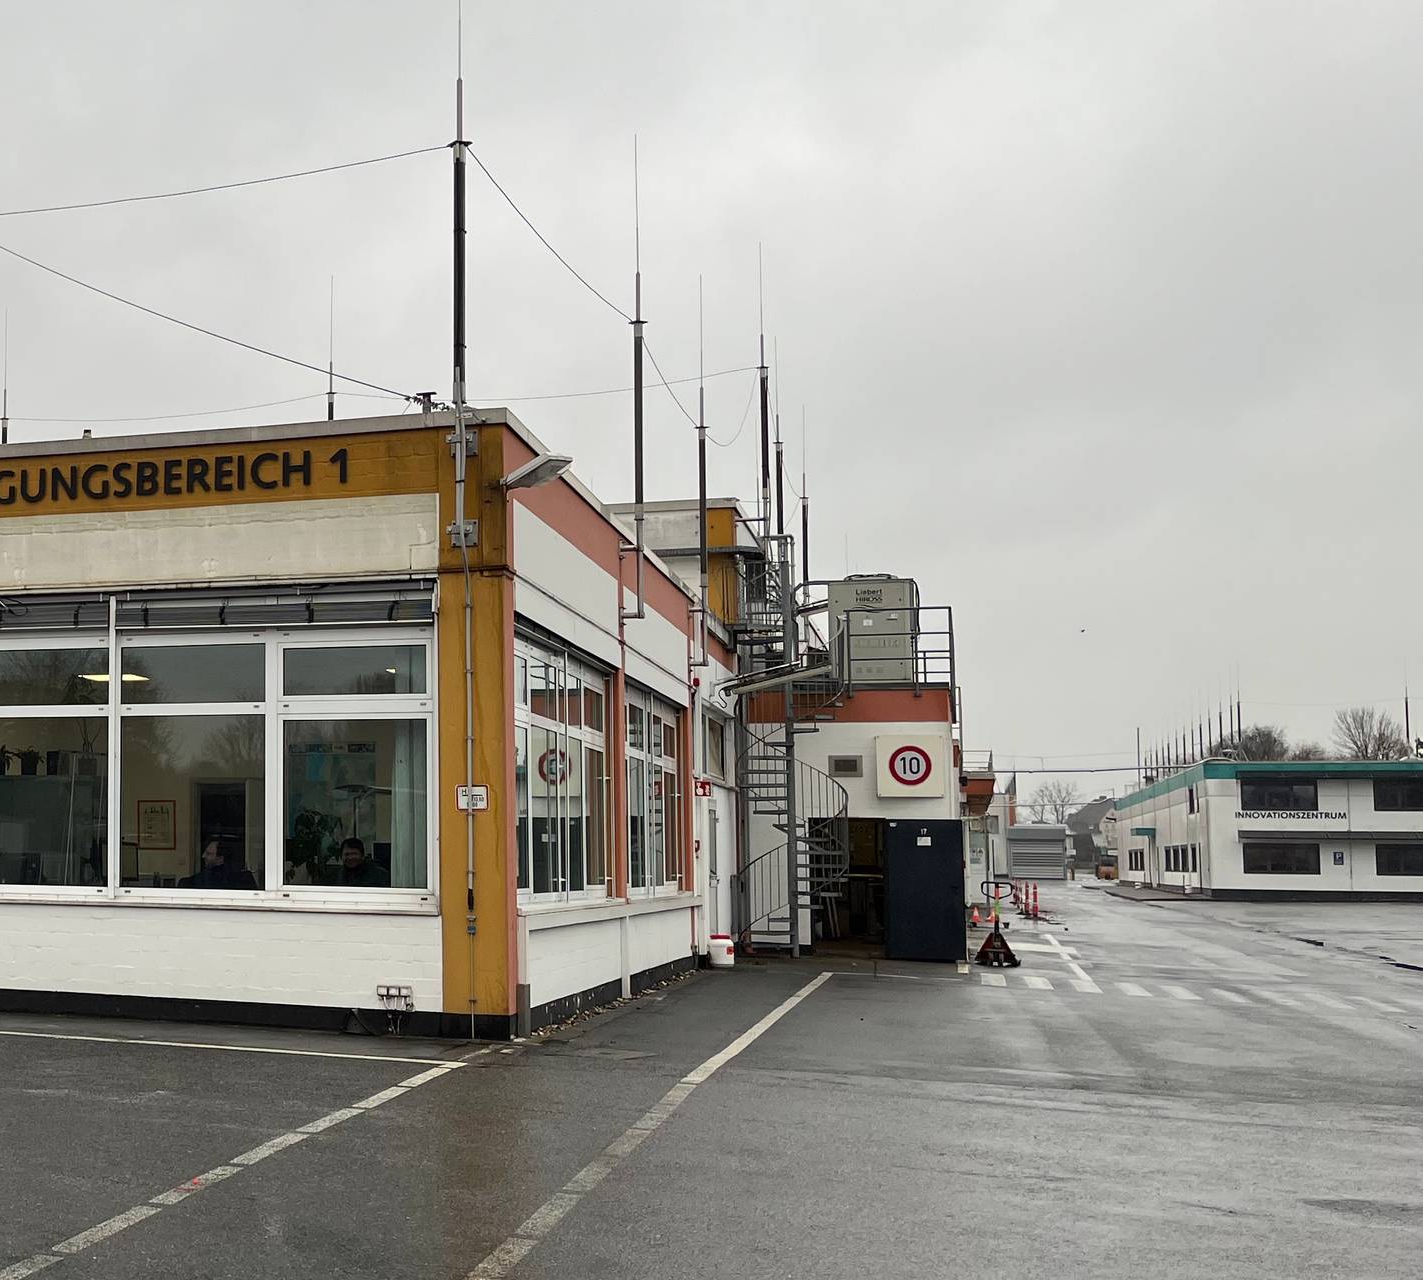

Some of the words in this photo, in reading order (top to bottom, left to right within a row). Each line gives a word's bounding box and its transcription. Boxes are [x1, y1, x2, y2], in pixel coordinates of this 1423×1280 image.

[329, 448, 348, 484] 1
[899, 756, 921, 775] 10
[1235, 811, 1347, 820] INNOVATIONSZENTRUM
